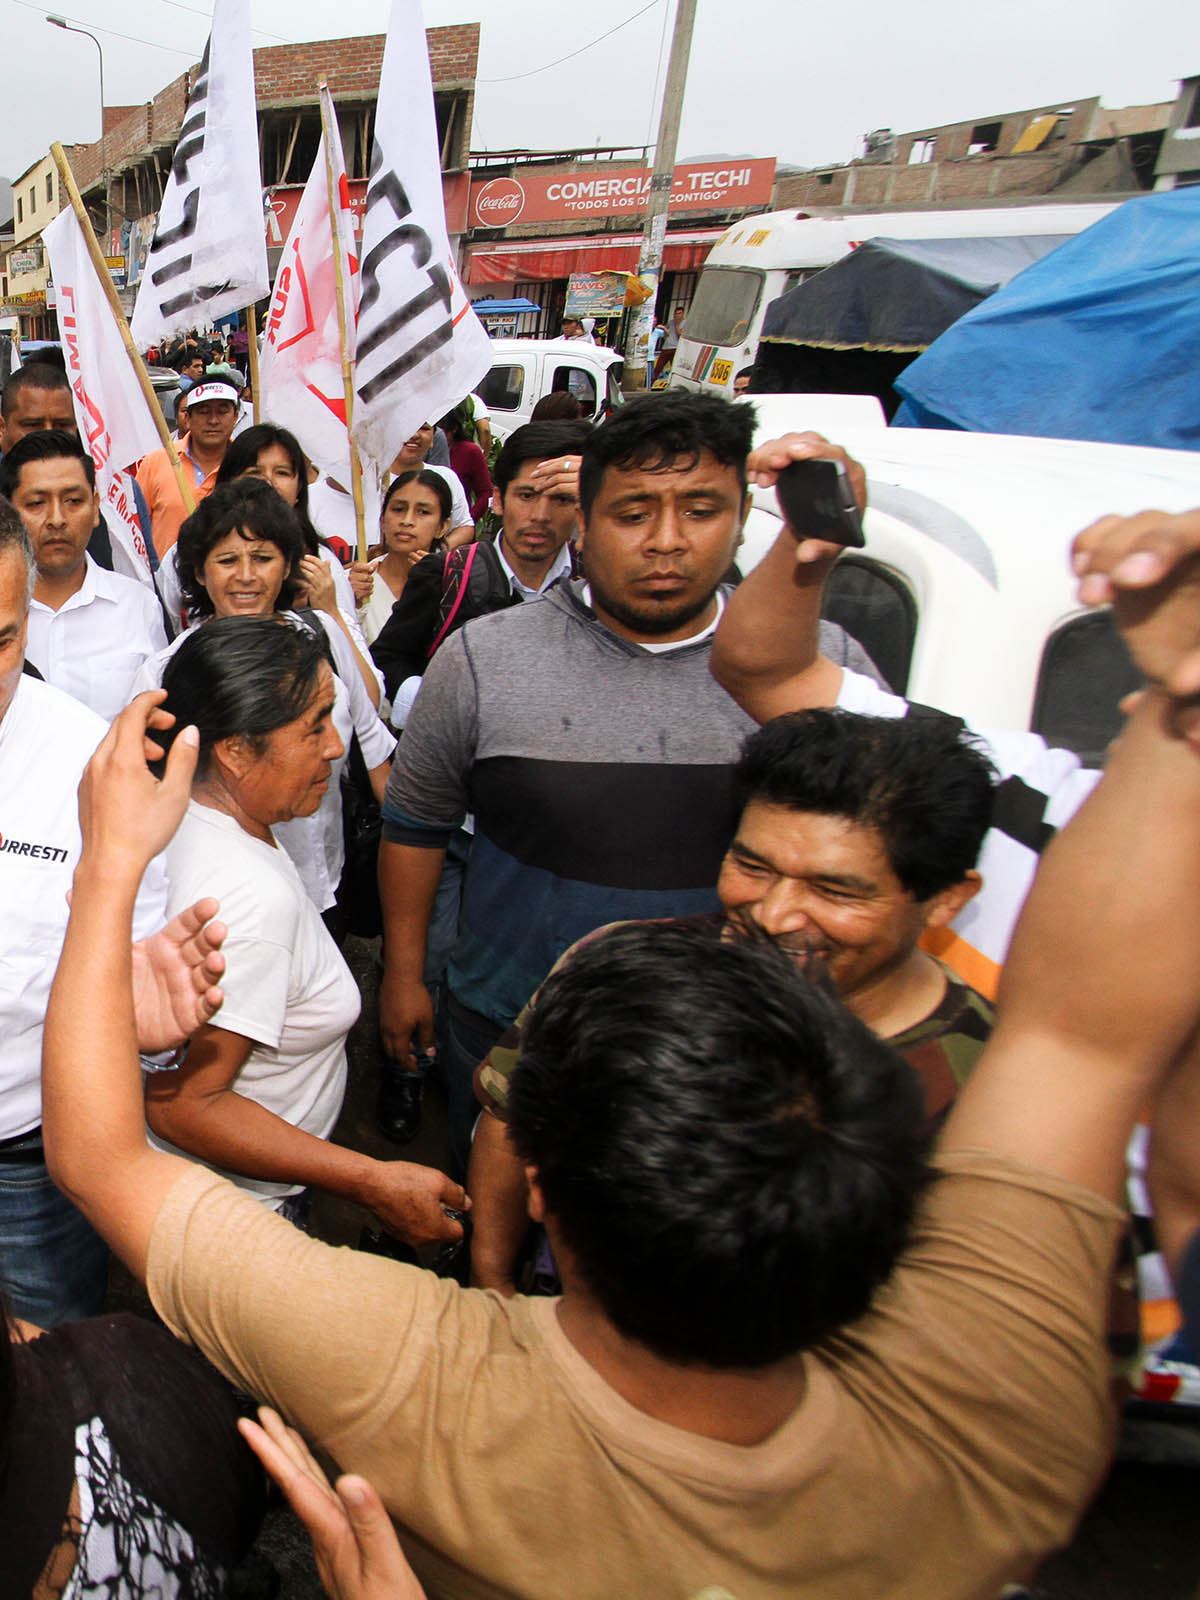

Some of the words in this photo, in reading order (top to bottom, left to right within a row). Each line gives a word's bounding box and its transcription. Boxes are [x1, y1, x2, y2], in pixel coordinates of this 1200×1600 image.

[547, 176, 653, 201] COMERCIA
[688, 168, 751, 191] TECHI
[612, 197, 634, 208] LOS
[569, 281, 606, 290] LLAVES
